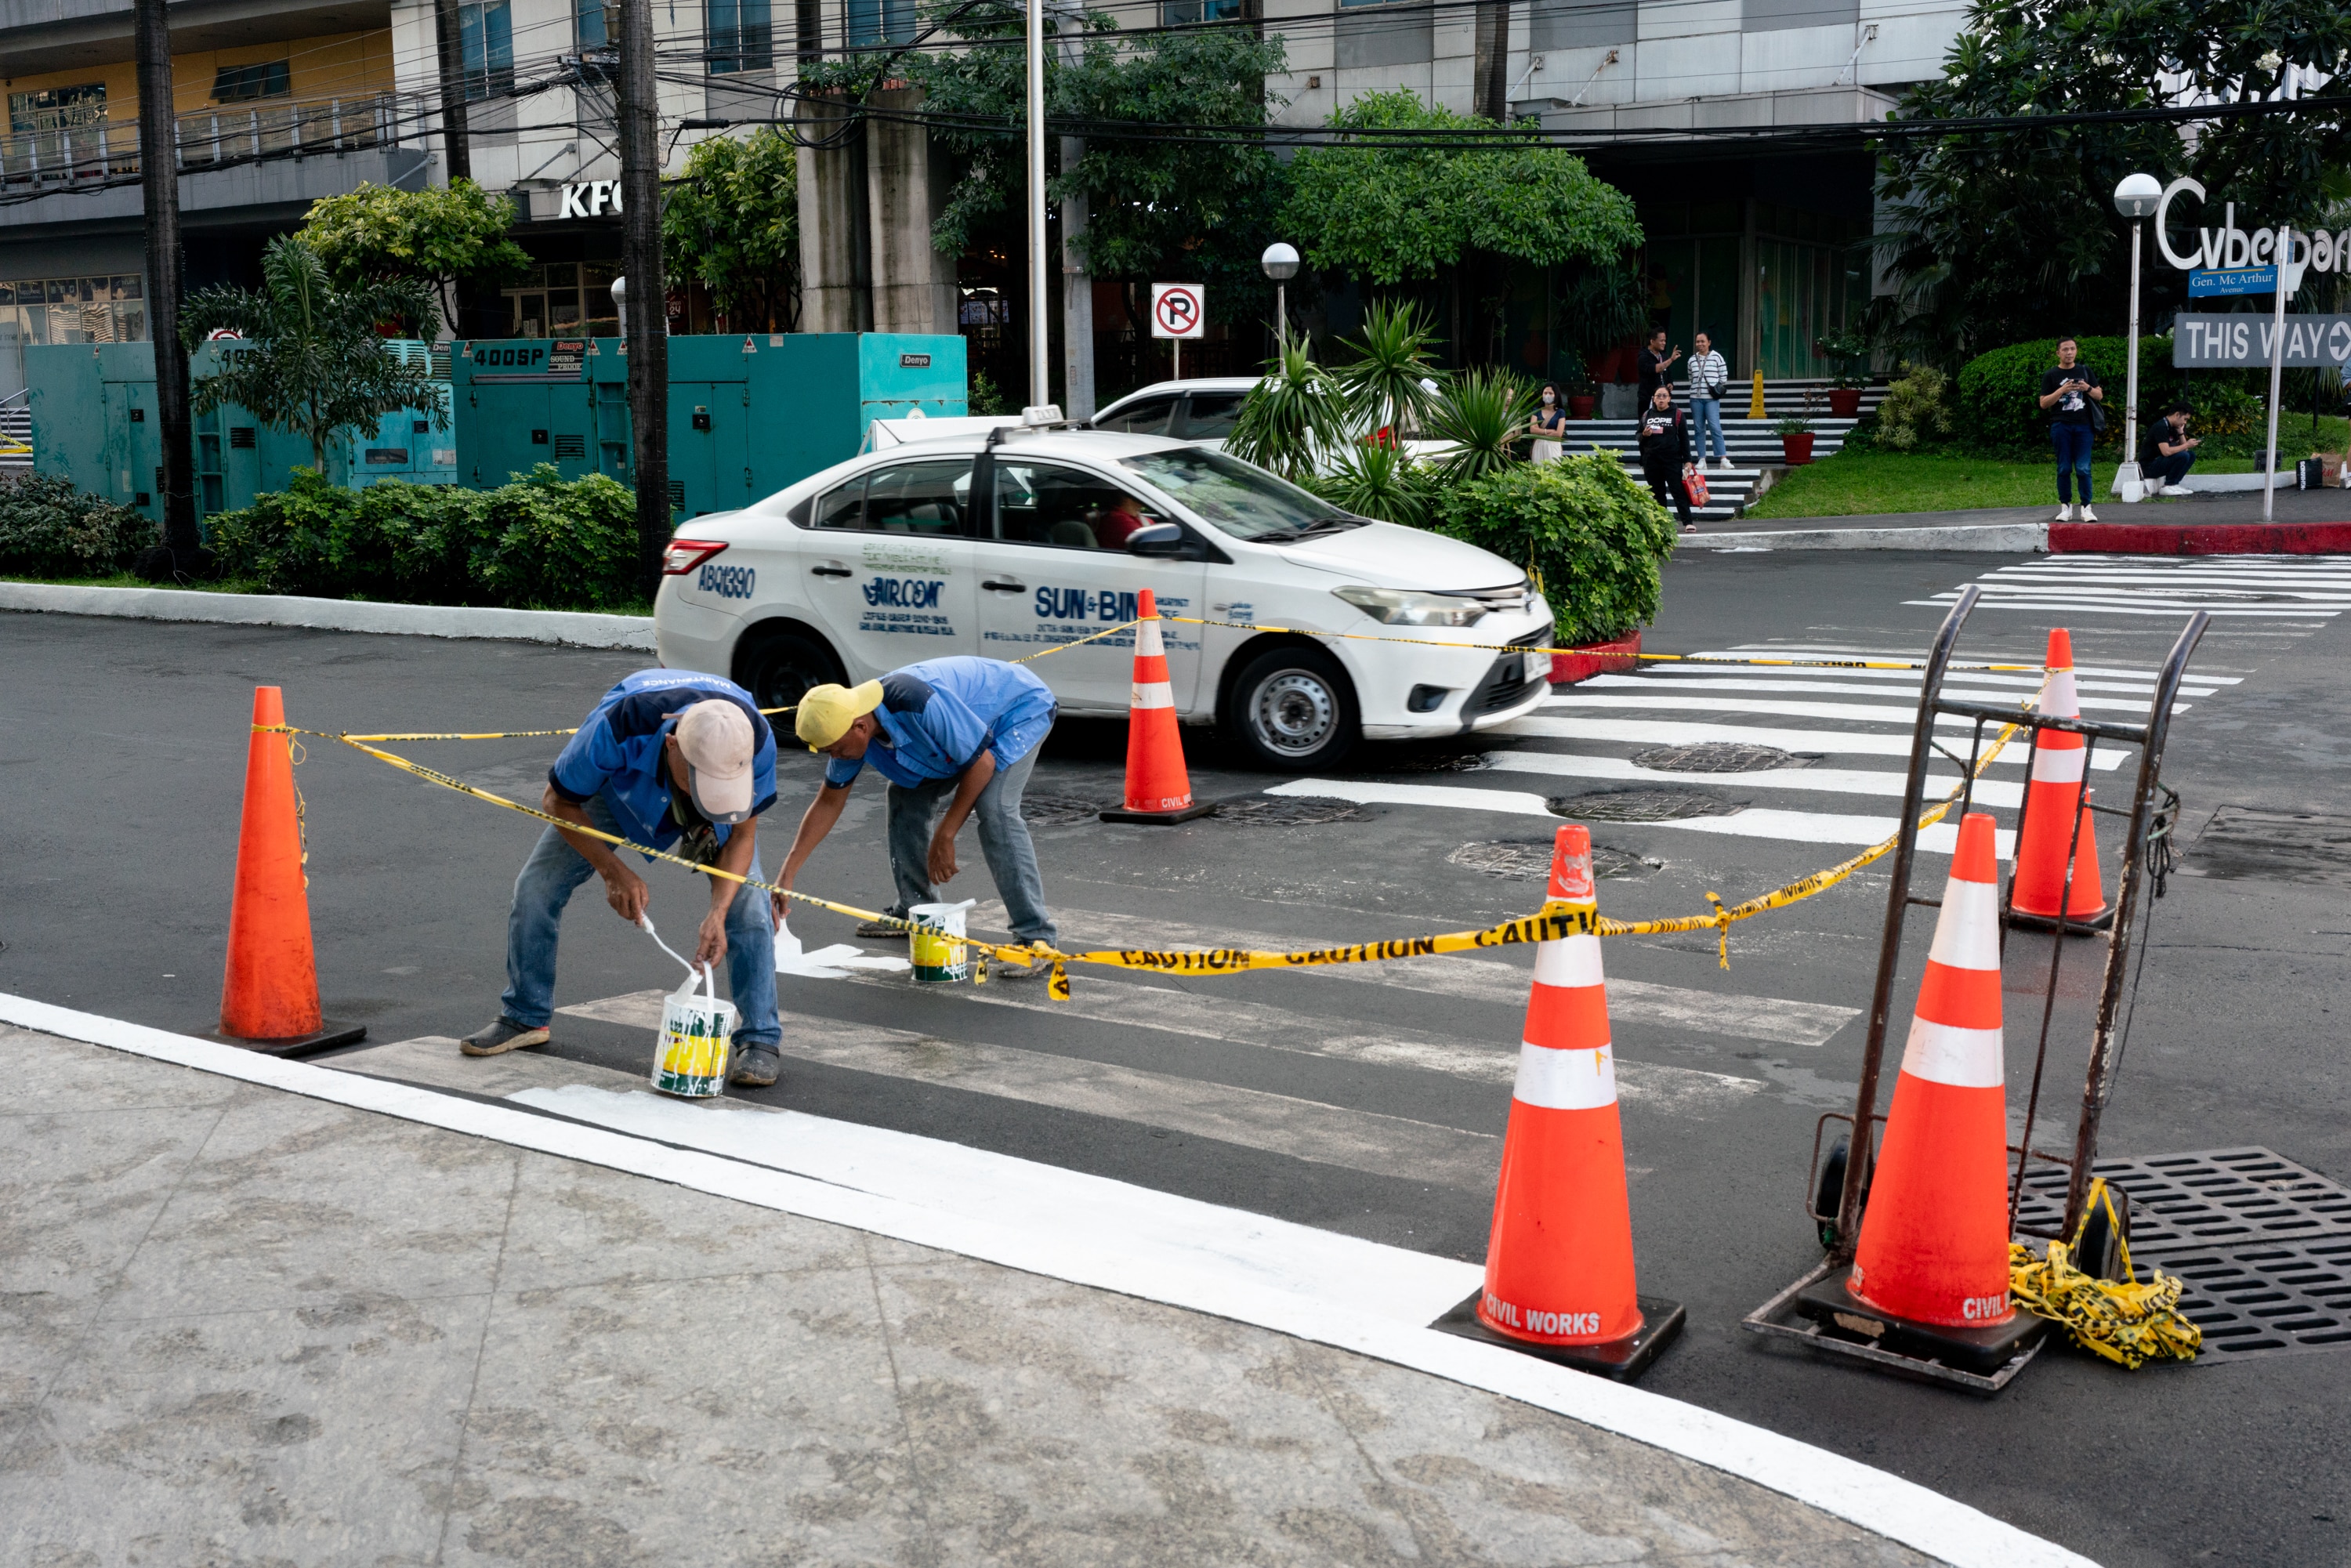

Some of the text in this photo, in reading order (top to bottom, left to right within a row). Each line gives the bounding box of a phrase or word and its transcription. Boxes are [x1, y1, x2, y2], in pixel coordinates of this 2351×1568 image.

[2192, 273, 2273, 287] Gen. Mc Arthur
[669, 306, 681, 315] 24
[557, 342, 584, 352] Denyo
[2186, 322, 2325, 360] THIS WAY
[474, 349, 544, 367] 400SP
[904, 355, 929, 365] Denyo
[643, 676, 731, 690] MAINTENANCE
[1161, 796, 1183, 809] CIVIL
[1285, 936, 1435, 965] CAUTION
[1120, 949, 1252, 970] CAUTION
[1486, 1292, 1601, 1336] CIVIL WORKS
[1963, 1294, 2003, 1320] CIVIL
